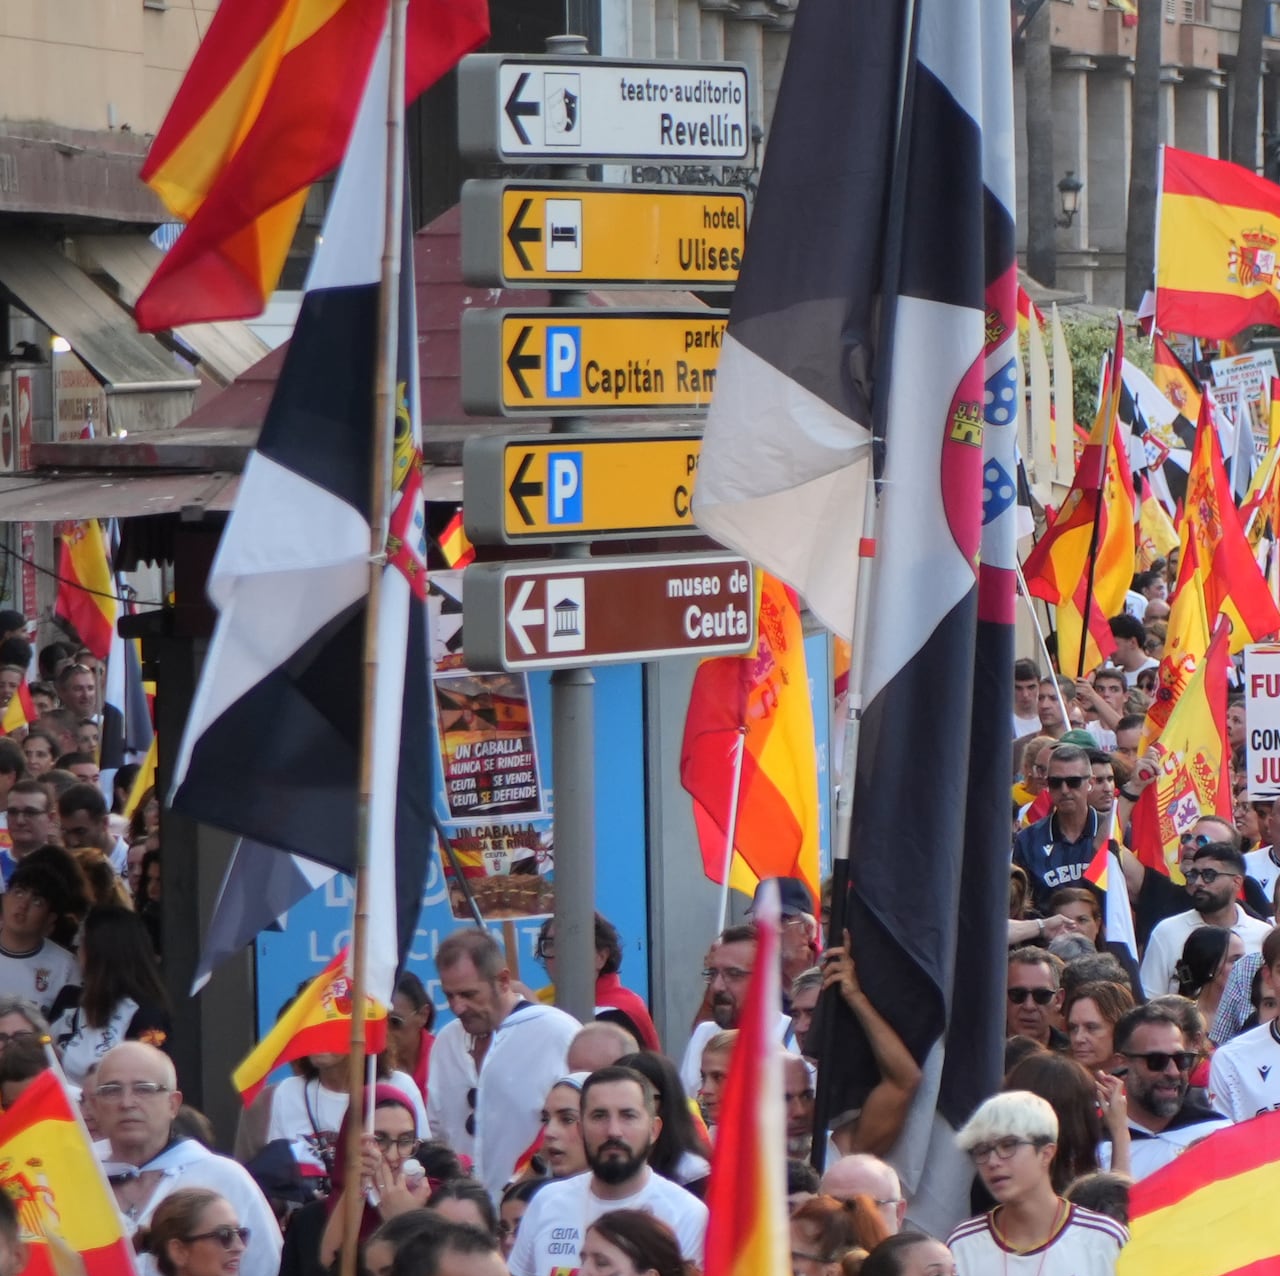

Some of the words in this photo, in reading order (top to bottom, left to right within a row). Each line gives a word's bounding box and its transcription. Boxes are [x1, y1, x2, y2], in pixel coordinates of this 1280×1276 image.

[621, 77, 742, 104] teatro-auditorio
[660, 113, 743, 147] Revellín
[703, 205, 741, 229] hotel
[679, 238, 741, 271] Ulises
[685, 325, 724, 352] parki
[552, 333, 577, 392] P
[585, 359, 664, 399] Capitán
[677, 360, 717, 393] Ram
[1214, 392, 1239, 405] CEUT
[554, 459, 578, 518] P
[667, 576, 720, 598] museo
[730, 569, 748, 594] de
[685, 603, 748, 639] Ceuta
[455, 744, 471, 760] UN
[474, 738, 523, 758] CABALLA
[450, 761, 480, 775] NUNCA
[483, 758, 495, 771] SE
[497, 754, 532, 769] RINDE!!
[450, 778, 477, 792] CEUTA
[493, 775, 503, 787] SE
[505, 771, 535, 786] VENDE,
[452, 792, 478, 807] CEUTA
[480, 791, 492, 804] SE
[493, 786, 537, 802] DEFIENDE
[456, 827, 472, 839] UN
[475, 822, 536, 839] CABALLA
[1043, 863, 1091, 888] CEU
[552, 1228, 580, 1240] CEUTA
[548, 1243, 576, 1255] CEUTA
